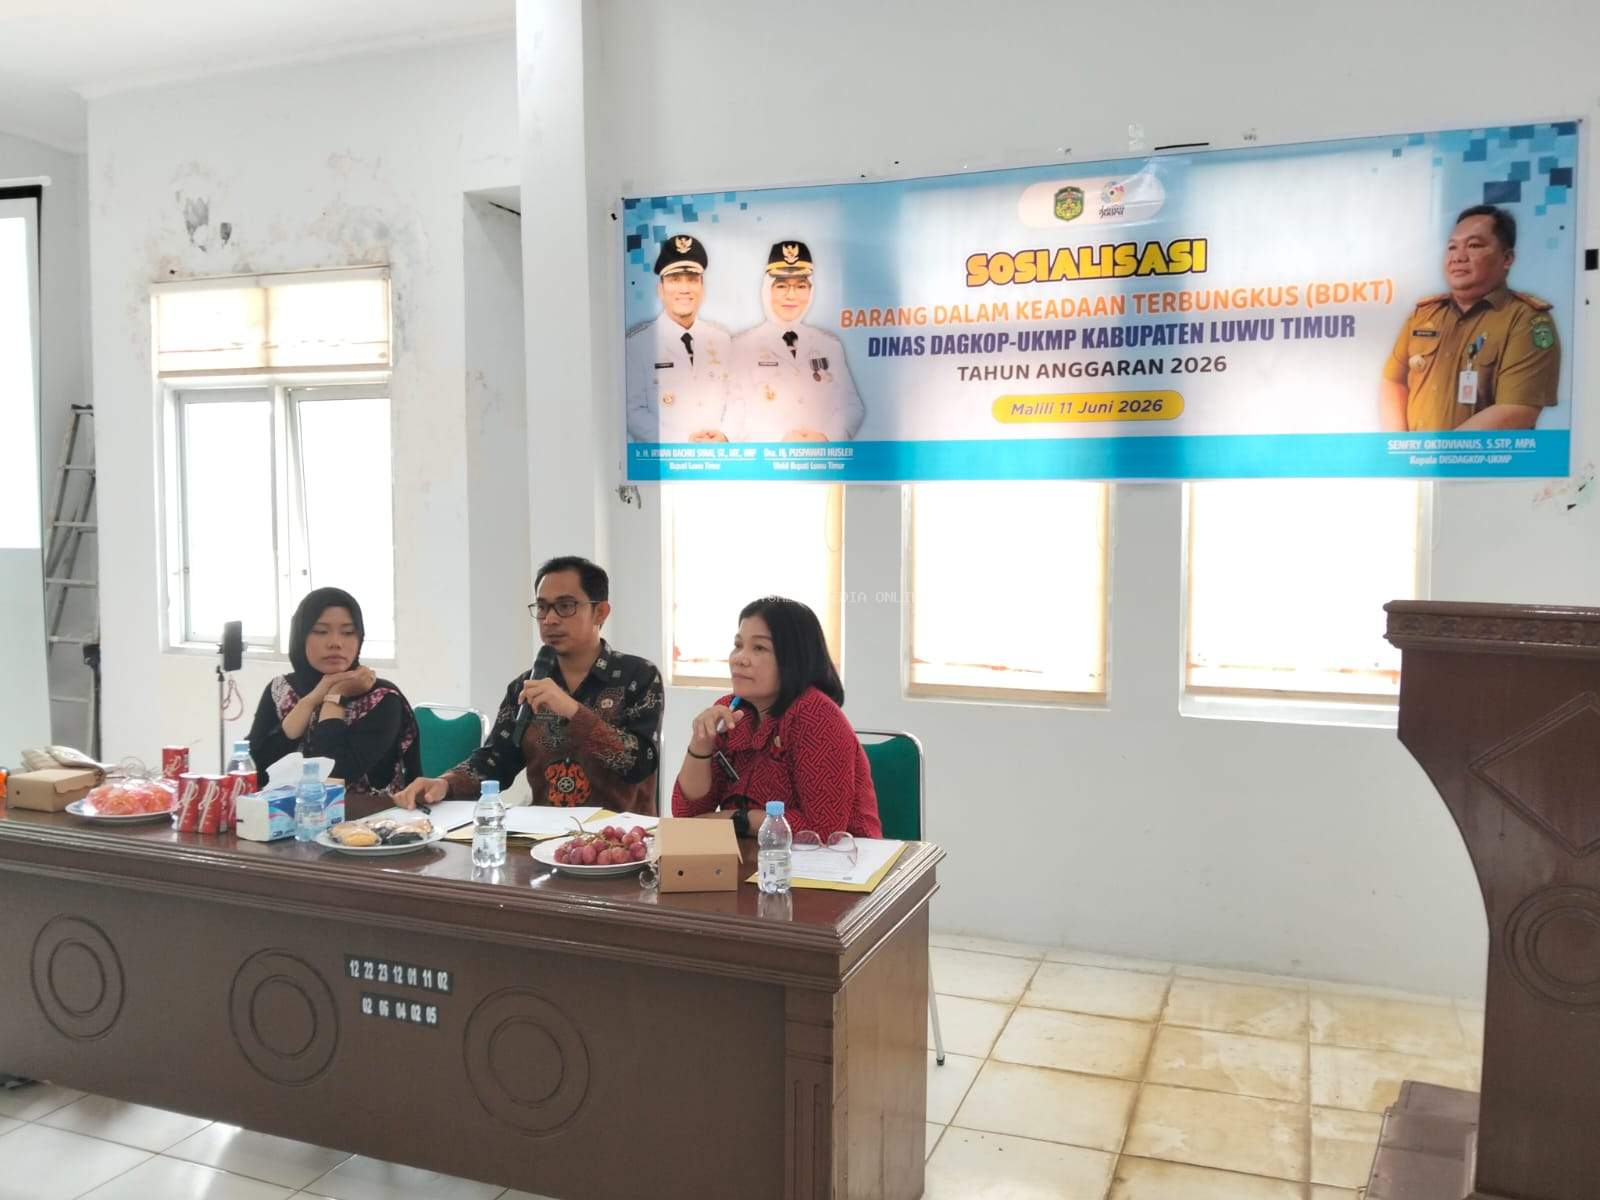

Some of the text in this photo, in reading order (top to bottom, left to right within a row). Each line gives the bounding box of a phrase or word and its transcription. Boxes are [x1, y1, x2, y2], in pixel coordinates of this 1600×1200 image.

[966, 238, 1207, 287] SOSIALISASI
[840, 279, 1394, 328] BARANG DALAM KEADAAN TERBUNGKUS (BDKT)
[868, 315, 1355, 357] DINAS DAGKOP-UKMP KABUPATEN LUWU TIMUR
[957, 356, 1227, 381] TAHUN ANGGARAN 2026
[1011, 399, 1163, 416] Malili 11 Juni 2026
[1515, 438, 1536, 449] MPA
[350, 960, 448, 991] 12 22 23 12 01 11 02
